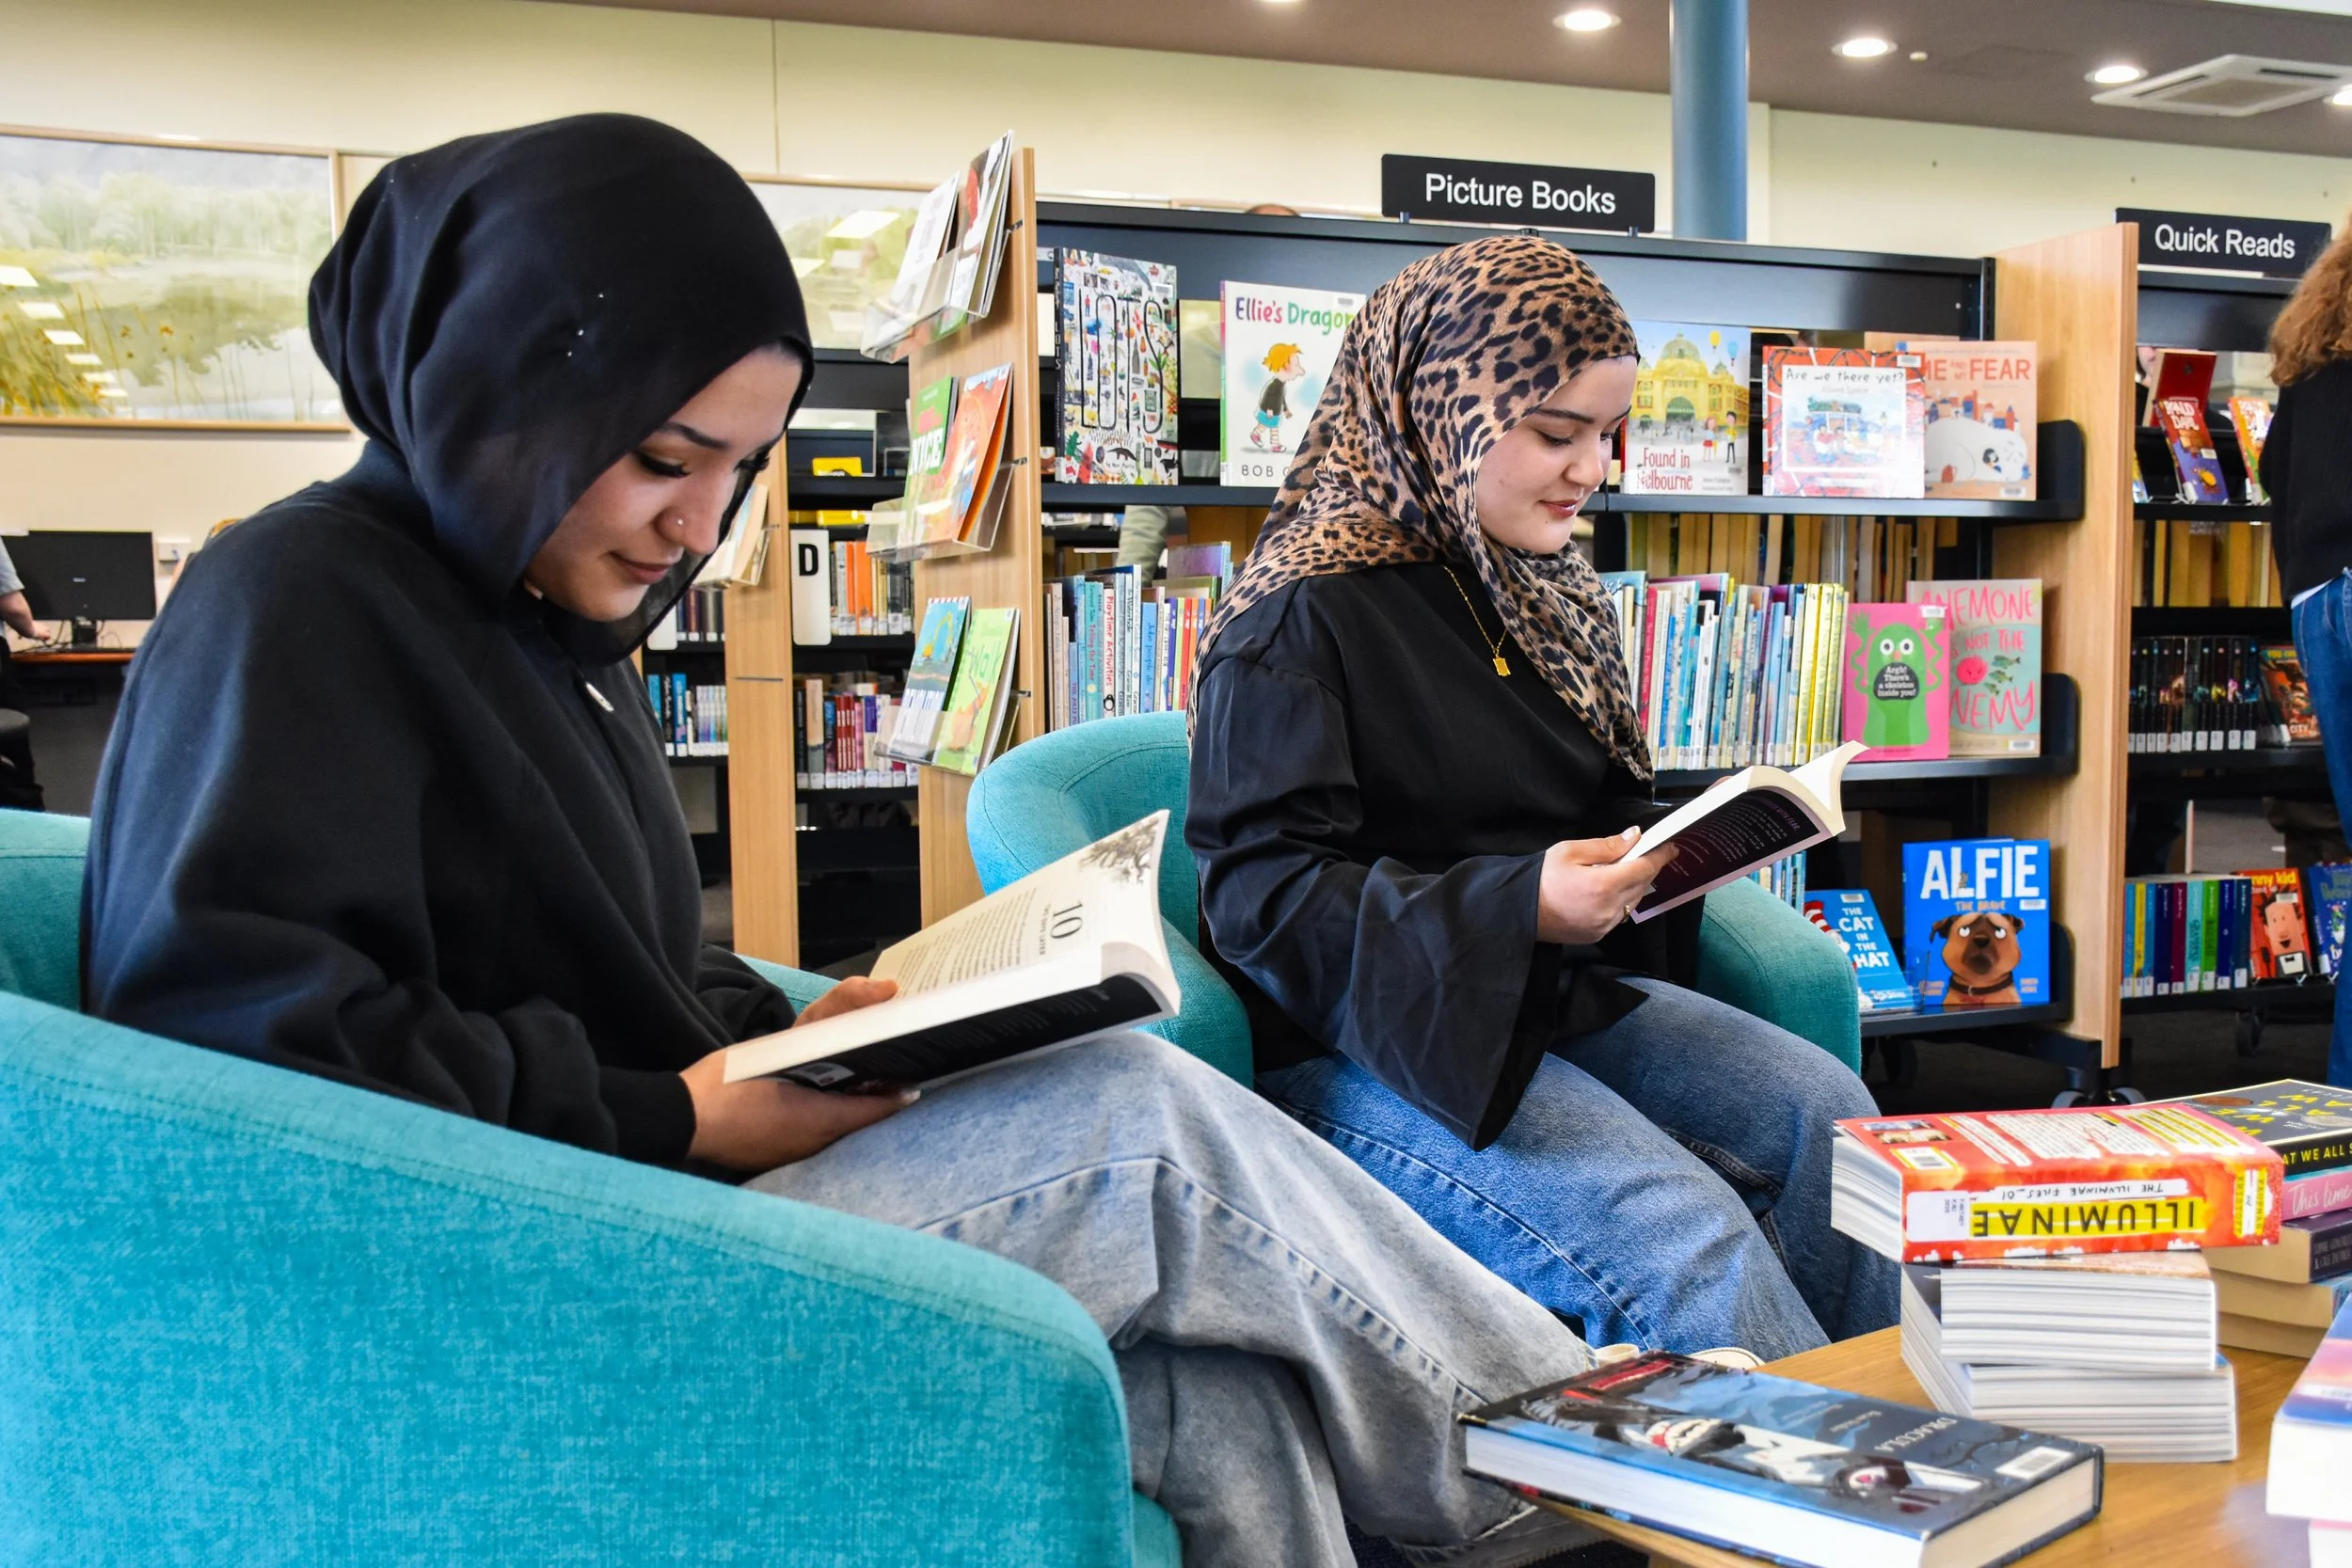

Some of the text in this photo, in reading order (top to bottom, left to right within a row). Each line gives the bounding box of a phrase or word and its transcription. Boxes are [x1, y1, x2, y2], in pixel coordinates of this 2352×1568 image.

[1425, 173, 1616, 214] Picture Books
[2154, 224, 2296, 259] Quick Reads
[1235, 296, 1282, 325] Ellie's
[1079, 288, 1164, 435] LOTS
[1969, 358, 2031, 381] FEAR
[1786, 368, 1904, 384] Are we there yet?
[910, 428, 944, 475] NICE
[1644, 447, 1691, 468] Found in
[1241, 465, 1274, 477] BOB
[799, 543, 818, 577] D
[1104, 595, 1116, 687] Playtime Activities
[1964, 631, 1990, 651] NOT
[1999, 628, 2027, 651] THE
[1920, 845, 2040, 900] ALFIE
[1050, 900, 1083, 939] 10
[1842, 907, 1863, 916] THE
[1838, 916, 1874, 932] CAT
[1855, 942, 1877, 951] THE
[1856, 932, 1868, 942] IN
[1853, 952, 1890, 969] HAT
[2301, 1148, 2319, 1163] WE
[2323, 1144, 2345, 1160] ALL
[2140, 1182, 2164, 1194] THE
[2289, 1181, 2319, 1216] This
[1973, 1201, 2195, 1237] ILLUMINAE
[1874, 1418, 1958, 1451] DRACULA
